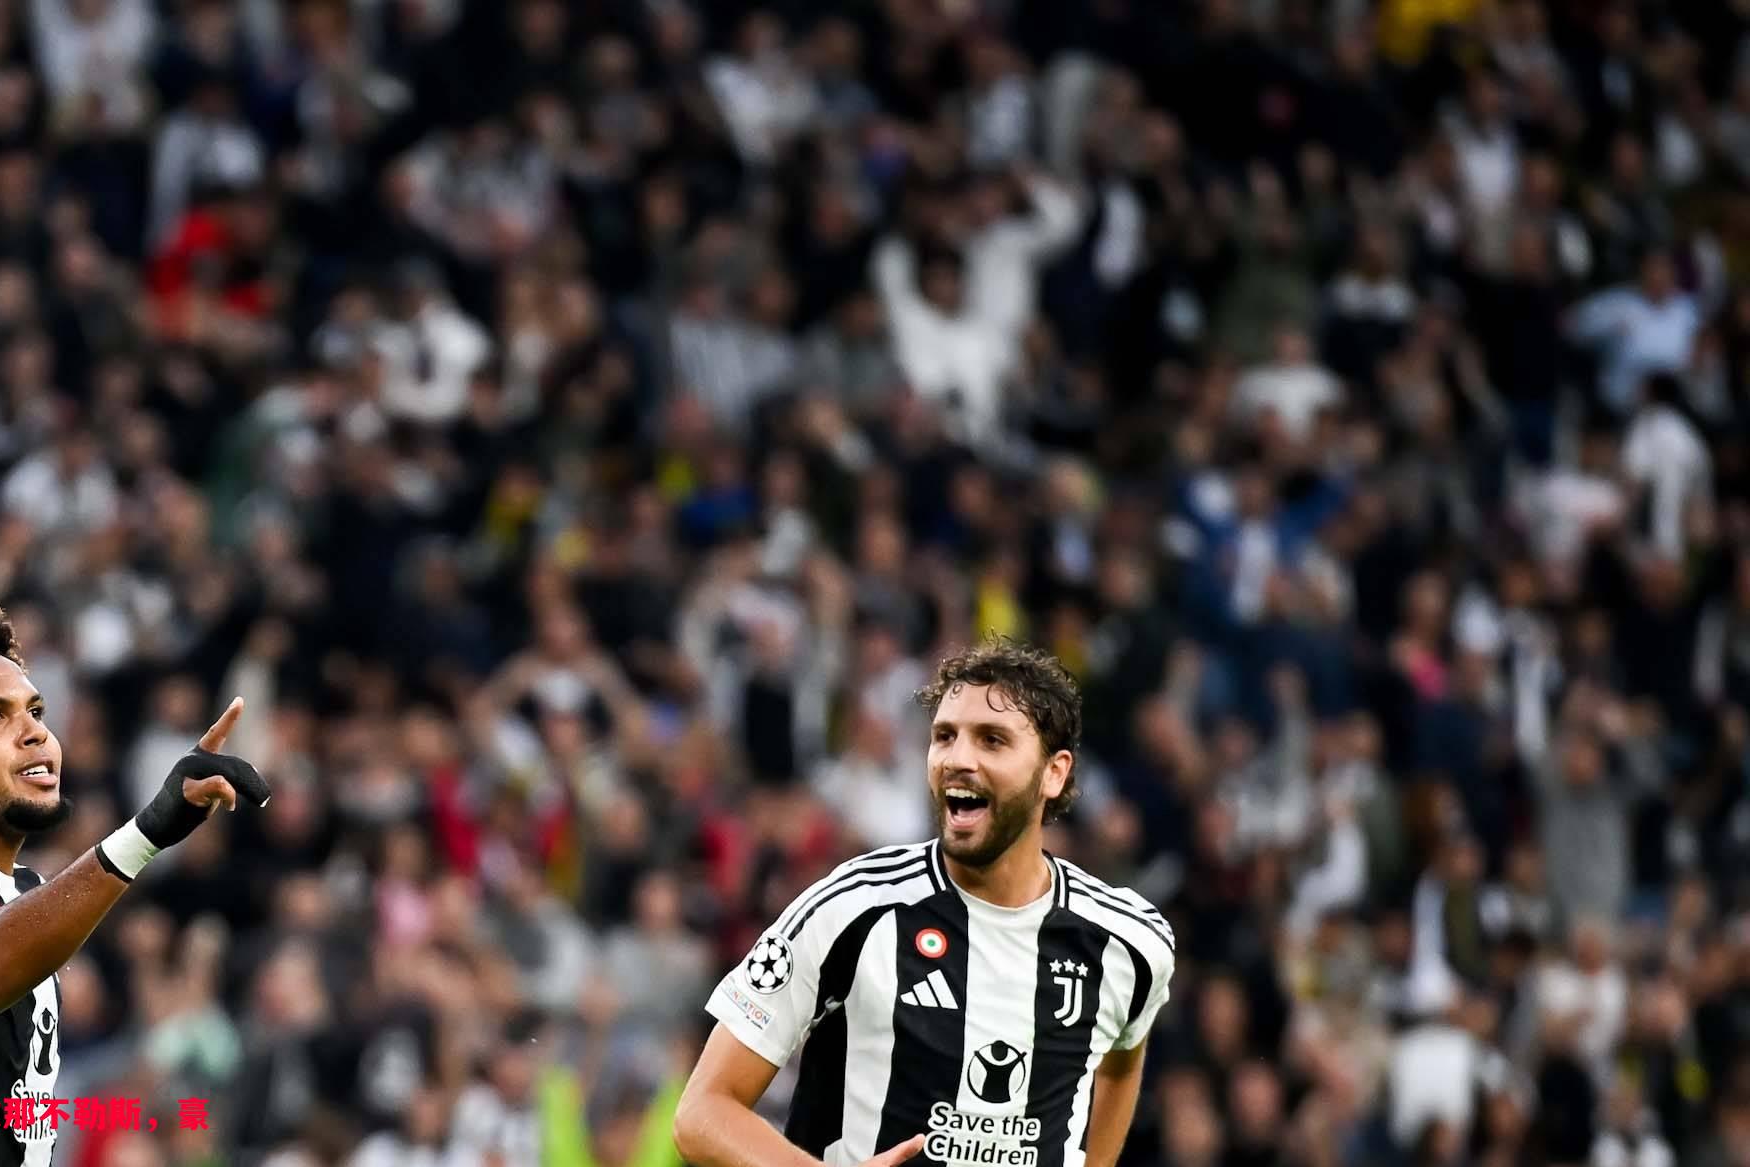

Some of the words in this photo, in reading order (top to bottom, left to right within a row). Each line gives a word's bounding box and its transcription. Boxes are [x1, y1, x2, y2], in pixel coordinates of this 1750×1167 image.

[932, 1105, 995, 1133] Save
[1002, 1115, 1038, 1136] the
[927, 1134, 1035, 1165] Children
